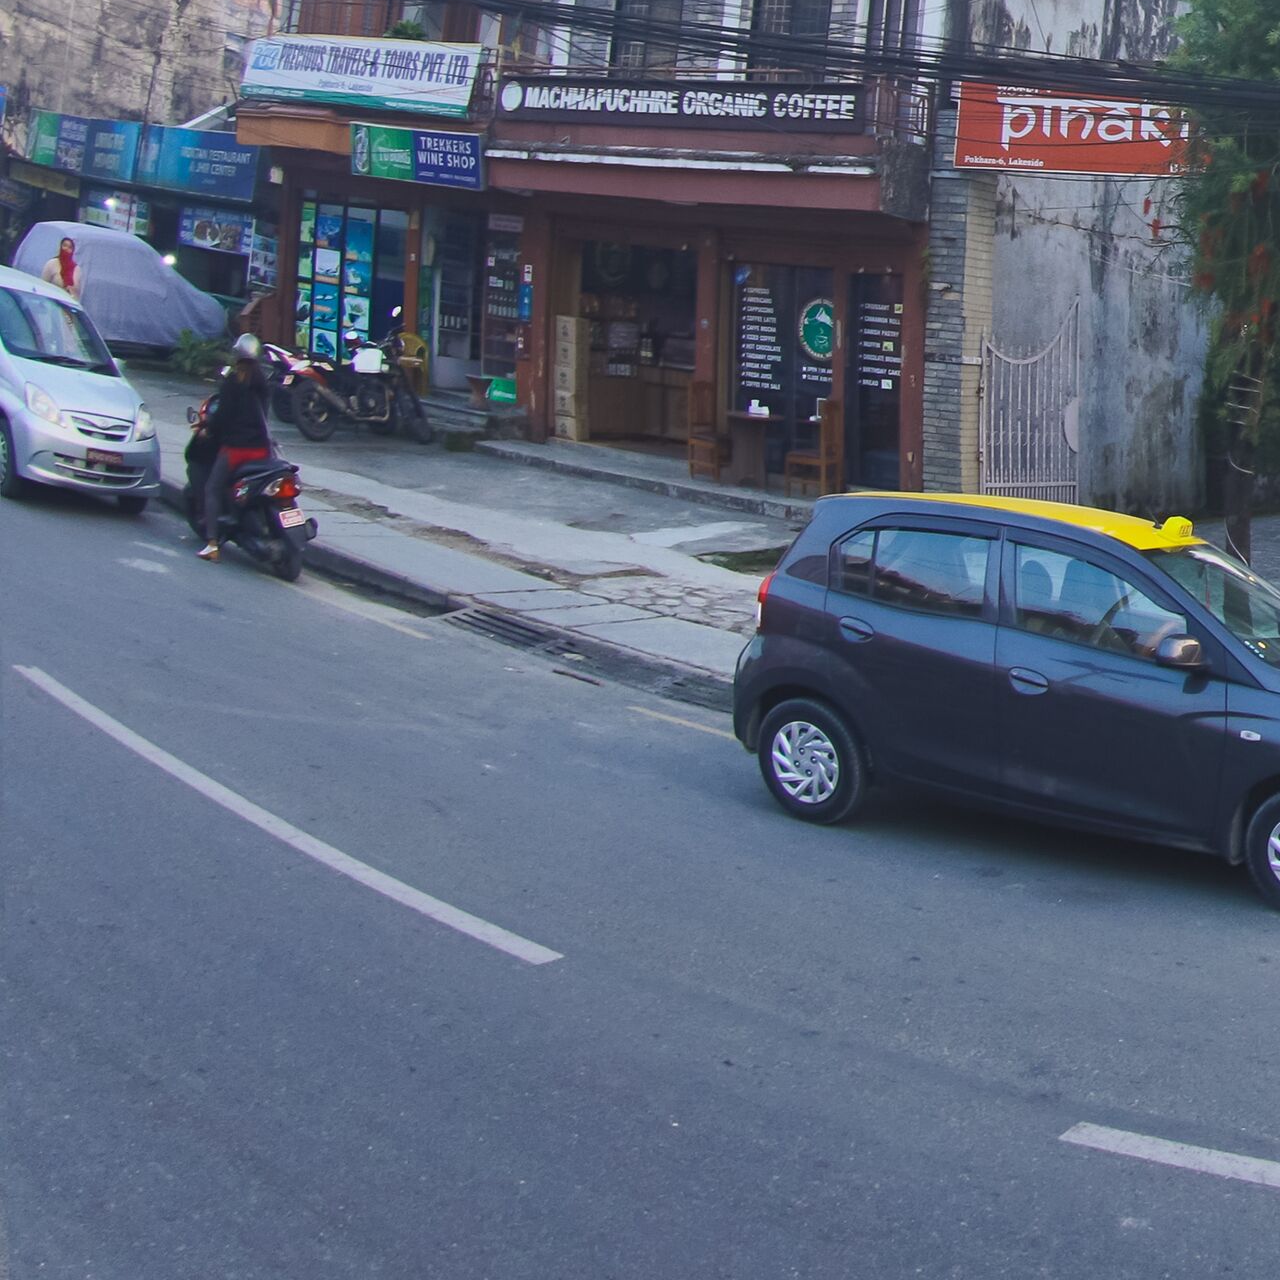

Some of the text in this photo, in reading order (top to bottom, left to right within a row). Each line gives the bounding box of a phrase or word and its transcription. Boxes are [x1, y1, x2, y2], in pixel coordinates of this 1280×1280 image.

[278, 43, 326, 72] PRECIOUS
[327, 46, 370, 77] TRAVELS
[381, 50, 419, 81] TOURS
[445, 55, 469, 87] LTD.
[525, 86, 856, 120] MACHHAPUCHHRE ORGANIC COFFEE
[420, 136, 471, 154] TREKKERS
[417, 151, 476, 169] WINE SHOP
[1008, 157, 1044, 167] Lakeside
